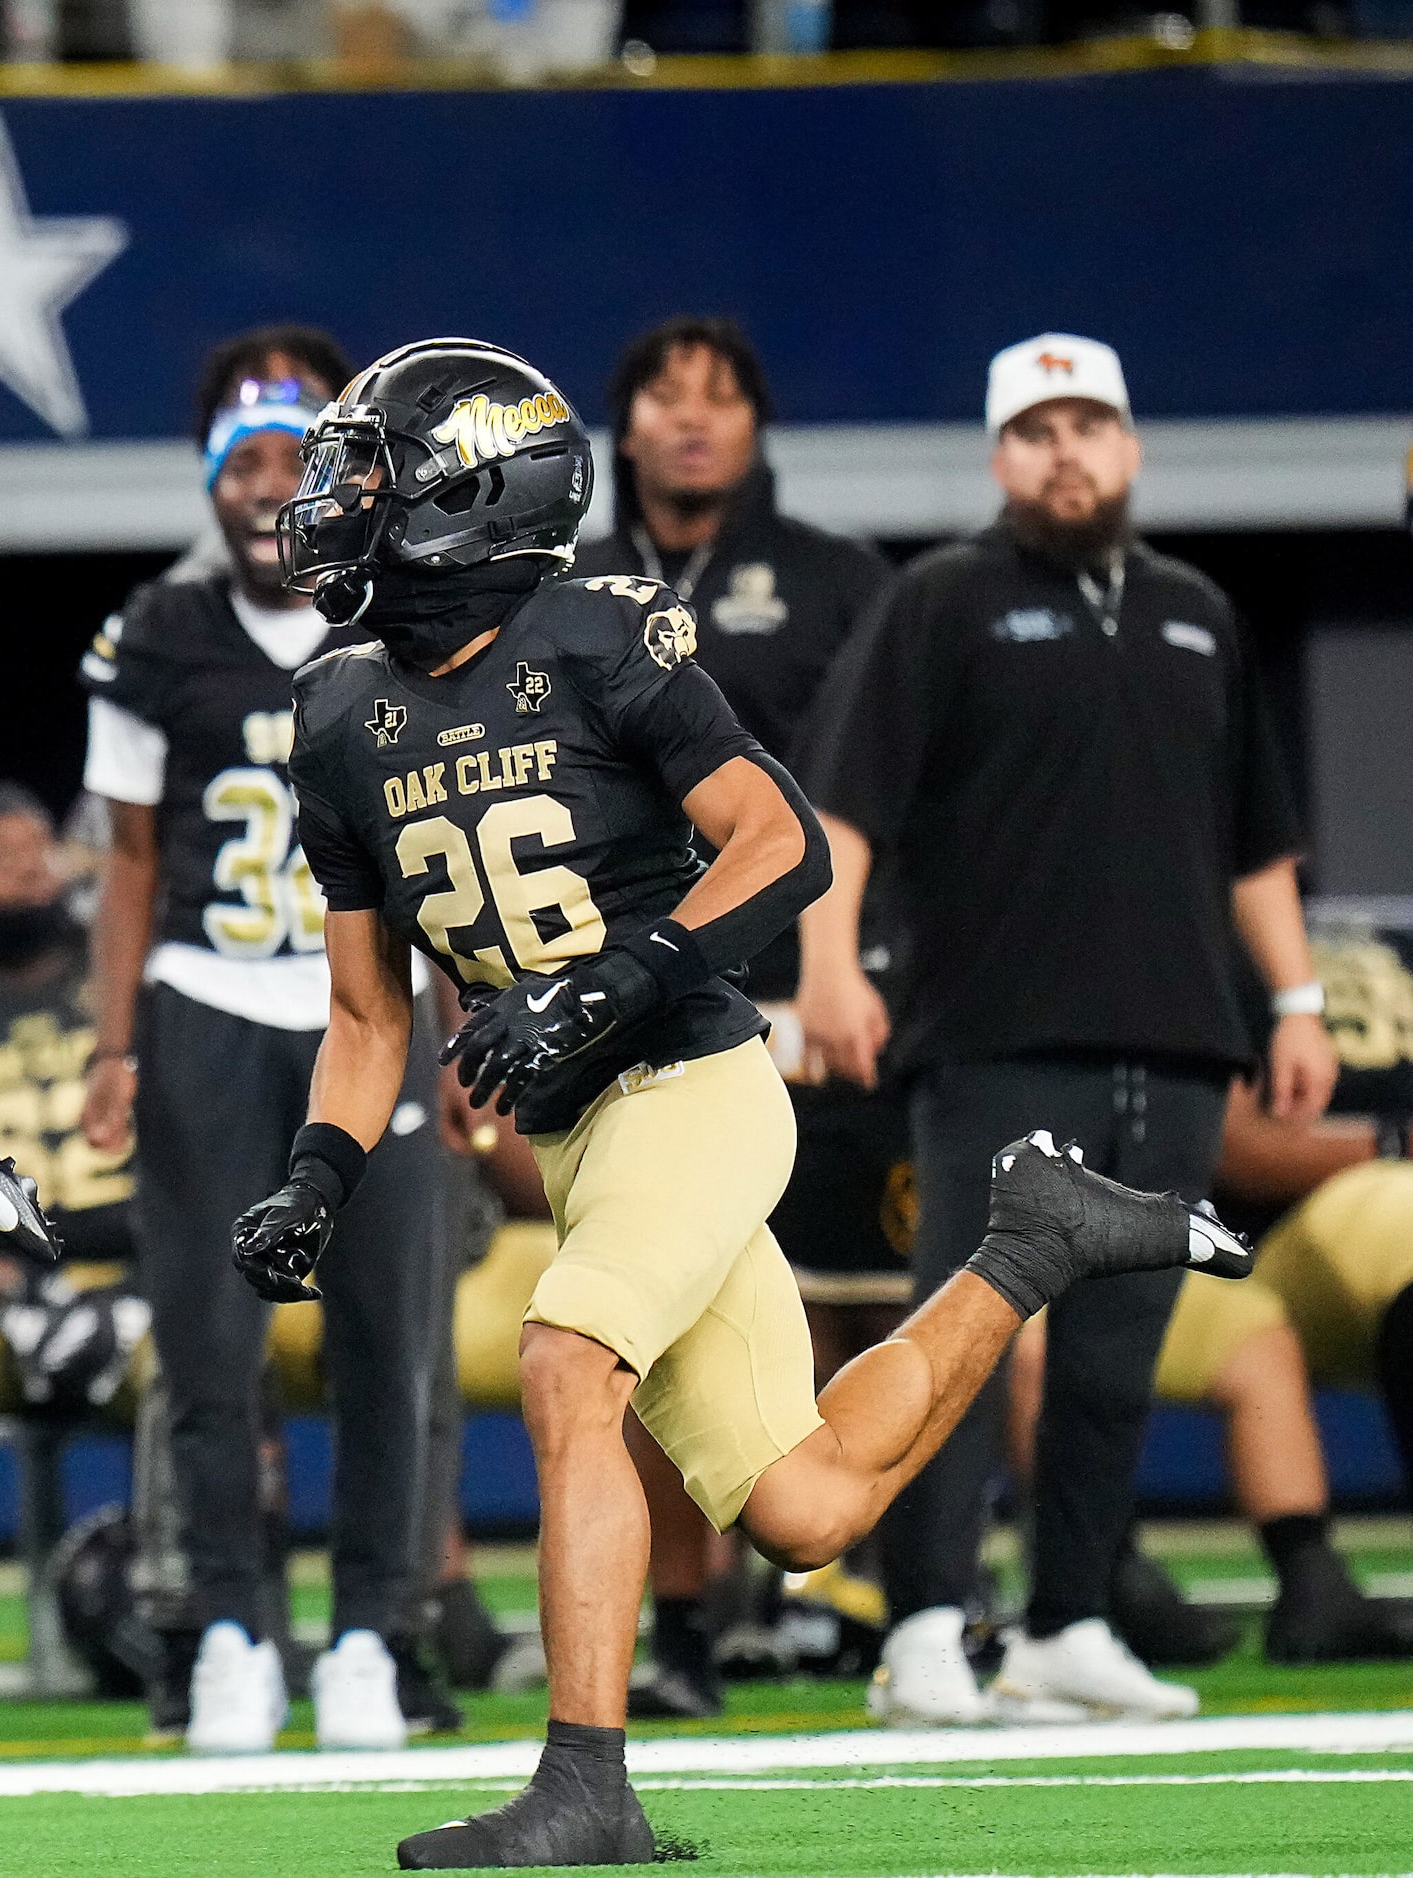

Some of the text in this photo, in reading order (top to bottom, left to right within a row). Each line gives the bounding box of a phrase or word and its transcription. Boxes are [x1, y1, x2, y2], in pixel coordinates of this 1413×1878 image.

[431, 393, 570, 468] Mecca
[525, 676, 545, 695] 22
[384, 710, 398, 729] 21
[440, 725, 481, 745] BATTLE
[383, 739, 558, 818] OAK CLIFF
[394, 793, 608, 991] 26
